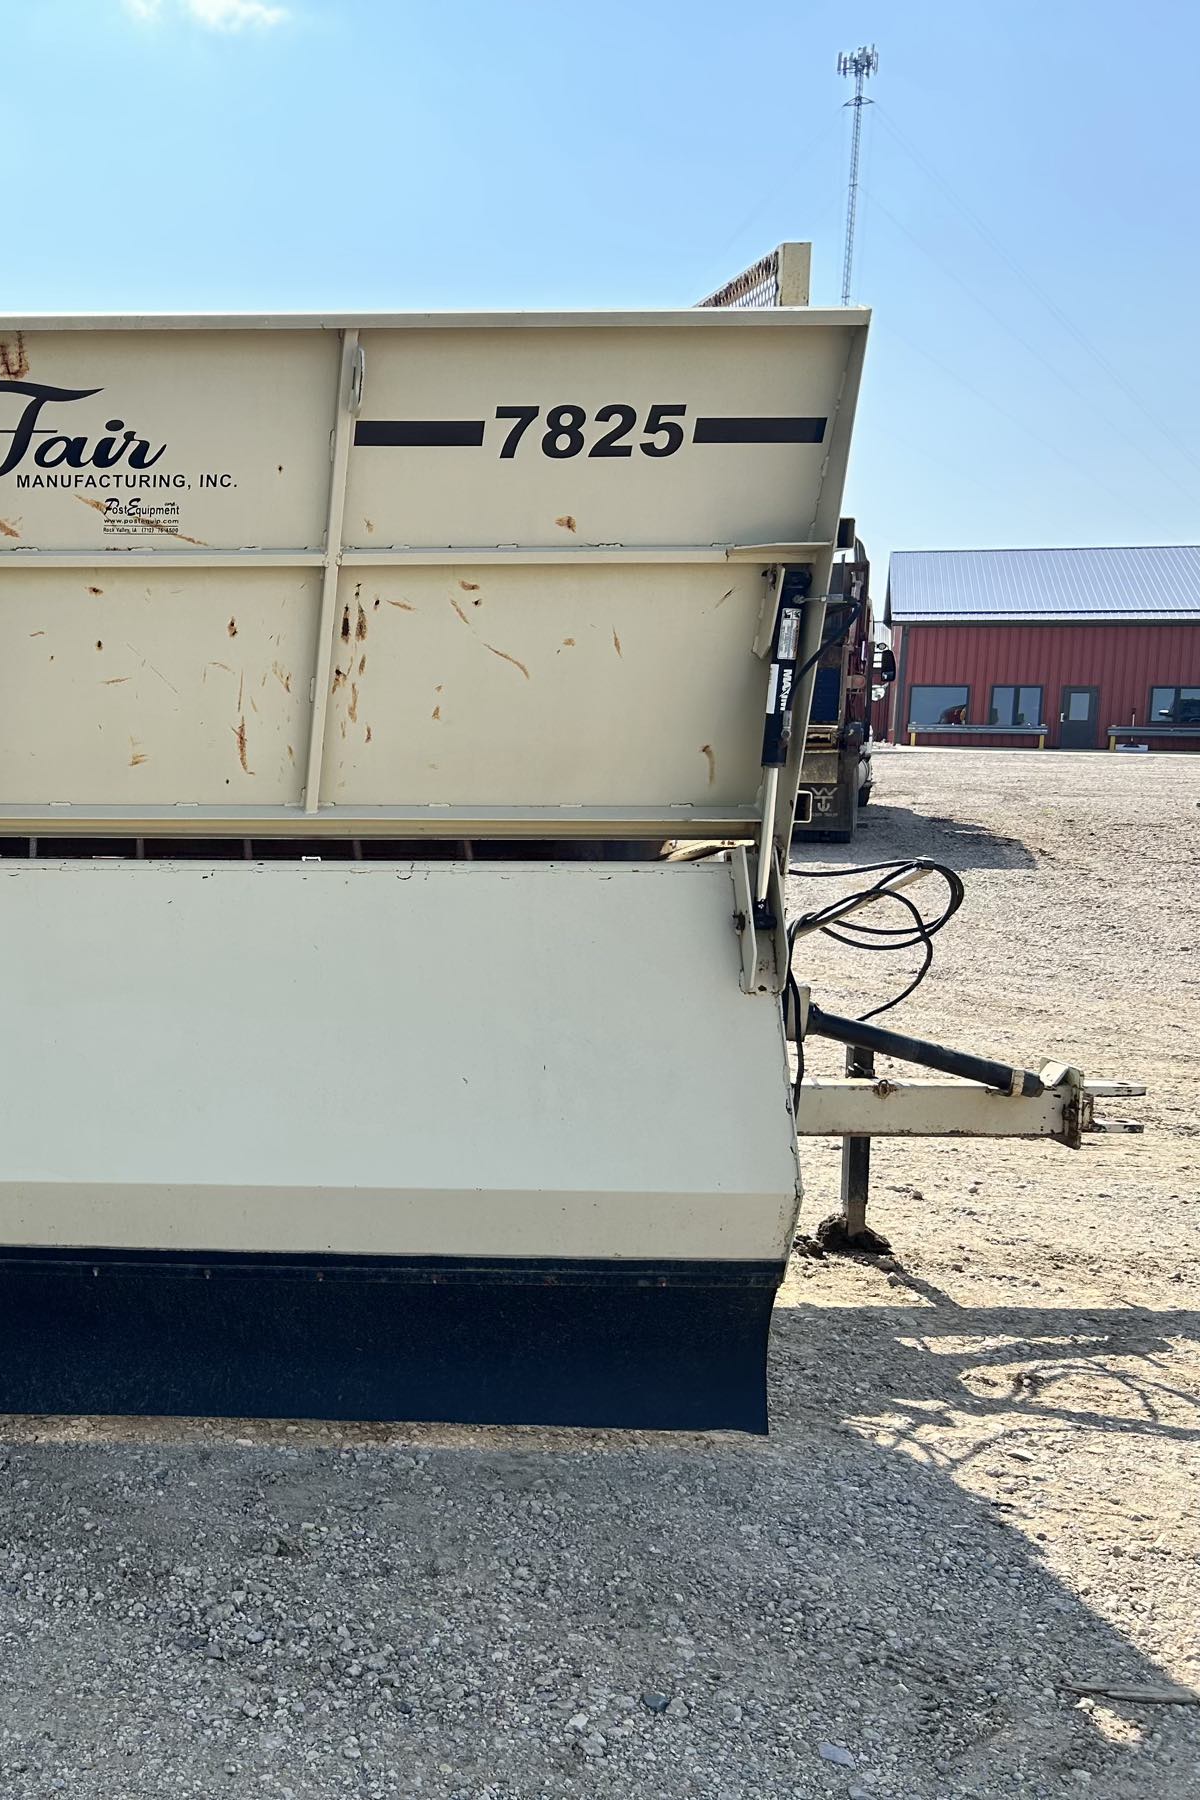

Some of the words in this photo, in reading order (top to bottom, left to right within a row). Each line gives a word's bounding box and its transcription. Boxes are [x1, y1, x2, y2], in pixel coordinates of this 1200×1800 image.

[494, 403, 687, 459] 7825
[16, 474, 192, 491] MANUFACTURING,
[199, 474, 238, 489] INC.
